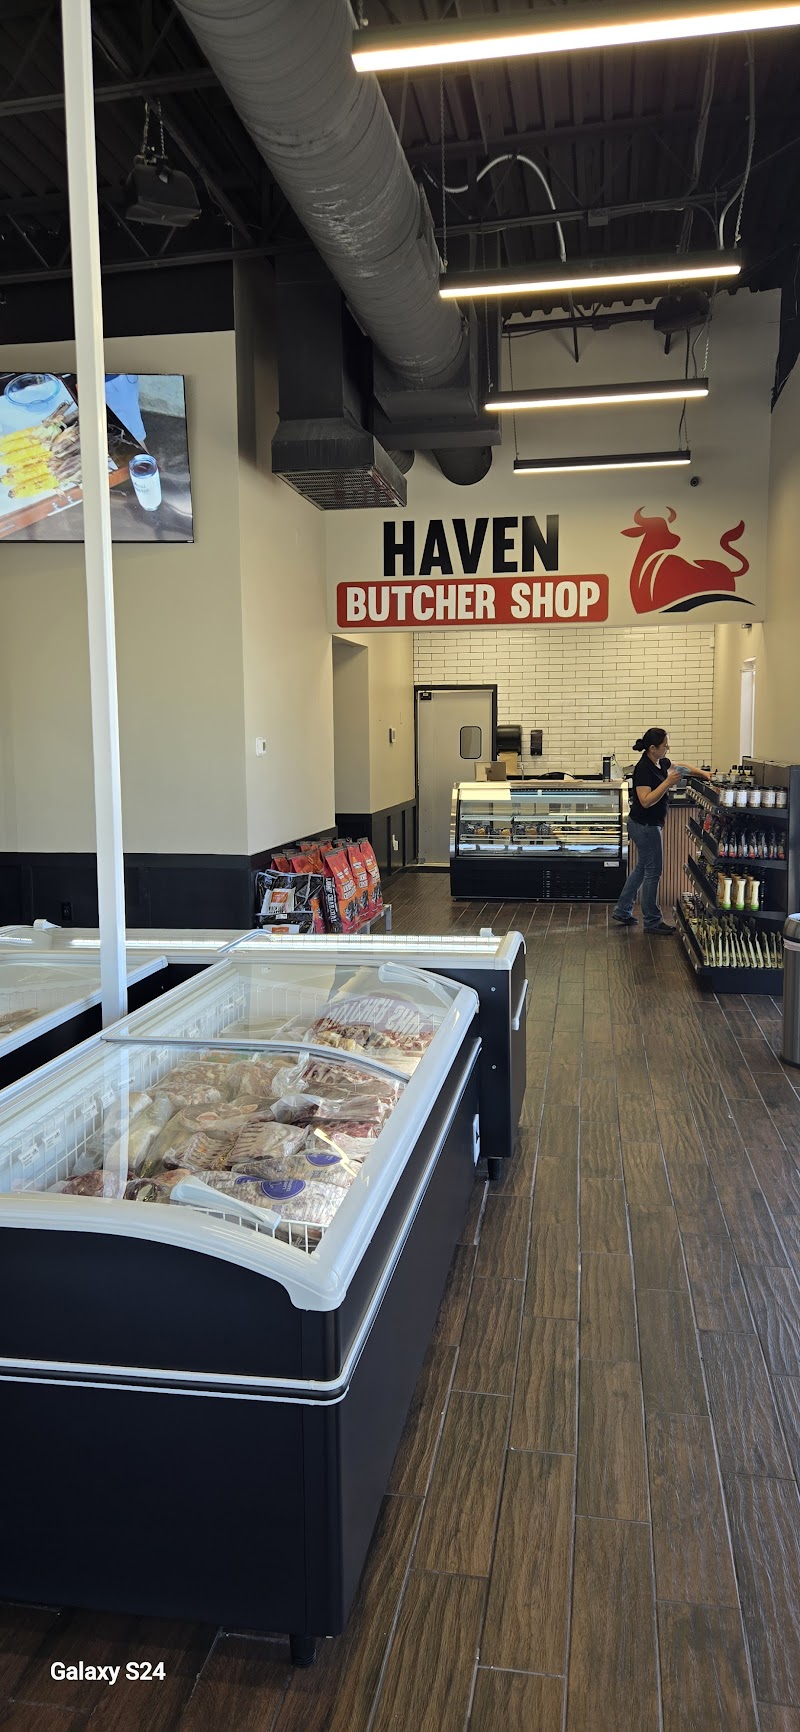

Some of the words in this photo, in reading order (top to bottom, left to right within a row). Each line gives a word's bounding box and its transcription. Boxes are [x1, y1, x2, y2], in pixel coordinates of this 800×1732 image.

[383, 514, 559, 576] HAVEN
[346, 583, 496, 622] BUTCHER
[510, 580, 600, 619] SHOP
